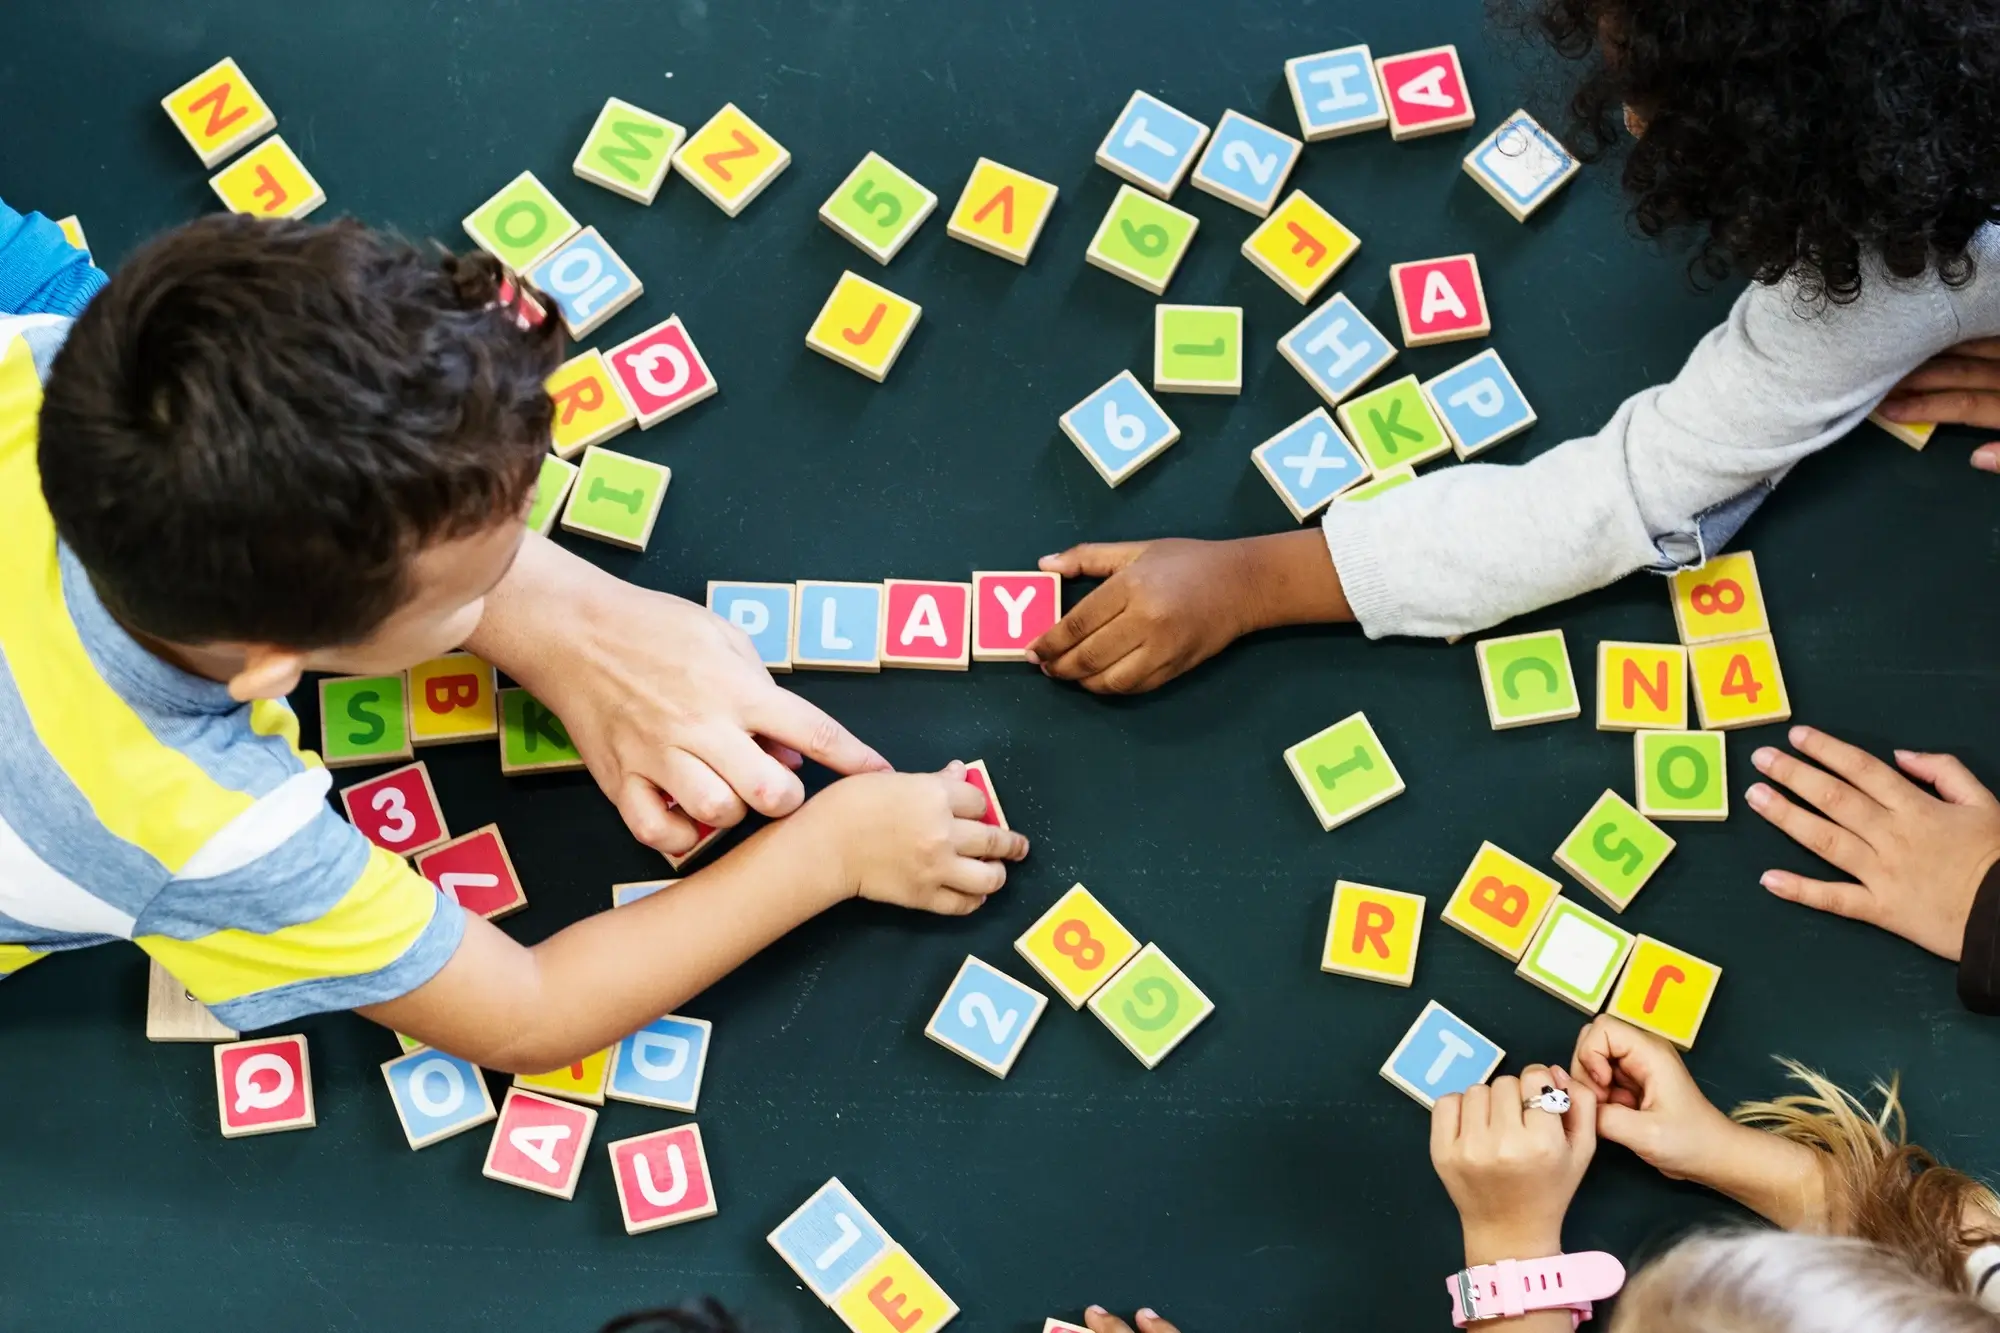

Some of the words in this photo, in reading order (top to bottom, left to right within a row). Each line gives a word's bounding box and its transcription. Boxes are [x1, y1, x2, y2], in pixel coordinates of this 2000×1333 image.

[1308, 64, 1368, 113] H
[1399, 67, 1453, 106] A
[1123, 117, 1176, 157] T
[255, 164, 286, 210] F
[1220, 139, 1278, 186] 2
[493, 200, 549, 250] O
[851, 177, 904, 229] 5
[1288, 223, 1325, 266] F
[1422, 272, 1465, 322] A
[841, 302, 889, 347] J
[1305, 316, 1372, 379] H
[627, 345, 688, 395] Q
[552, 376, 601, 424] R
[1448, 377, 1504, 417] P
[1368, 396, 1425, 456] K
[1282, 431, 1347, 489] X
[728, 586, 1036, 650] PLAY
[1691, 580, 1743, 613] 8
[426, 673, 479, 713] B
[1624, 660, 1667, 710] N
[1721, 655, 1762, 703] 4
[347, 690, 385, 745] S
[522, 700, 568, 753] K
[1656, 745, 1709, 800] O
[373, 788, 415, 841] 3
[1592, 821, 1645, 877] 5
[1471, 877, 1528, 927] B
[1052, 919, 1105, 971] 8
[1353, 902, 1394, 958] R
[958, 991, 1019, 1045] 2
[1121, 975, 1180, 1033] G
[632, 1032, 689, 1082] D
[1424, 1028, 1475, 1086] T
[235, 1054, 293, 1113] Q
[510, 1125, 570, 1173] A
[634, 1145, 687, 1205] U
[868, 1276, 922, 1332] E
